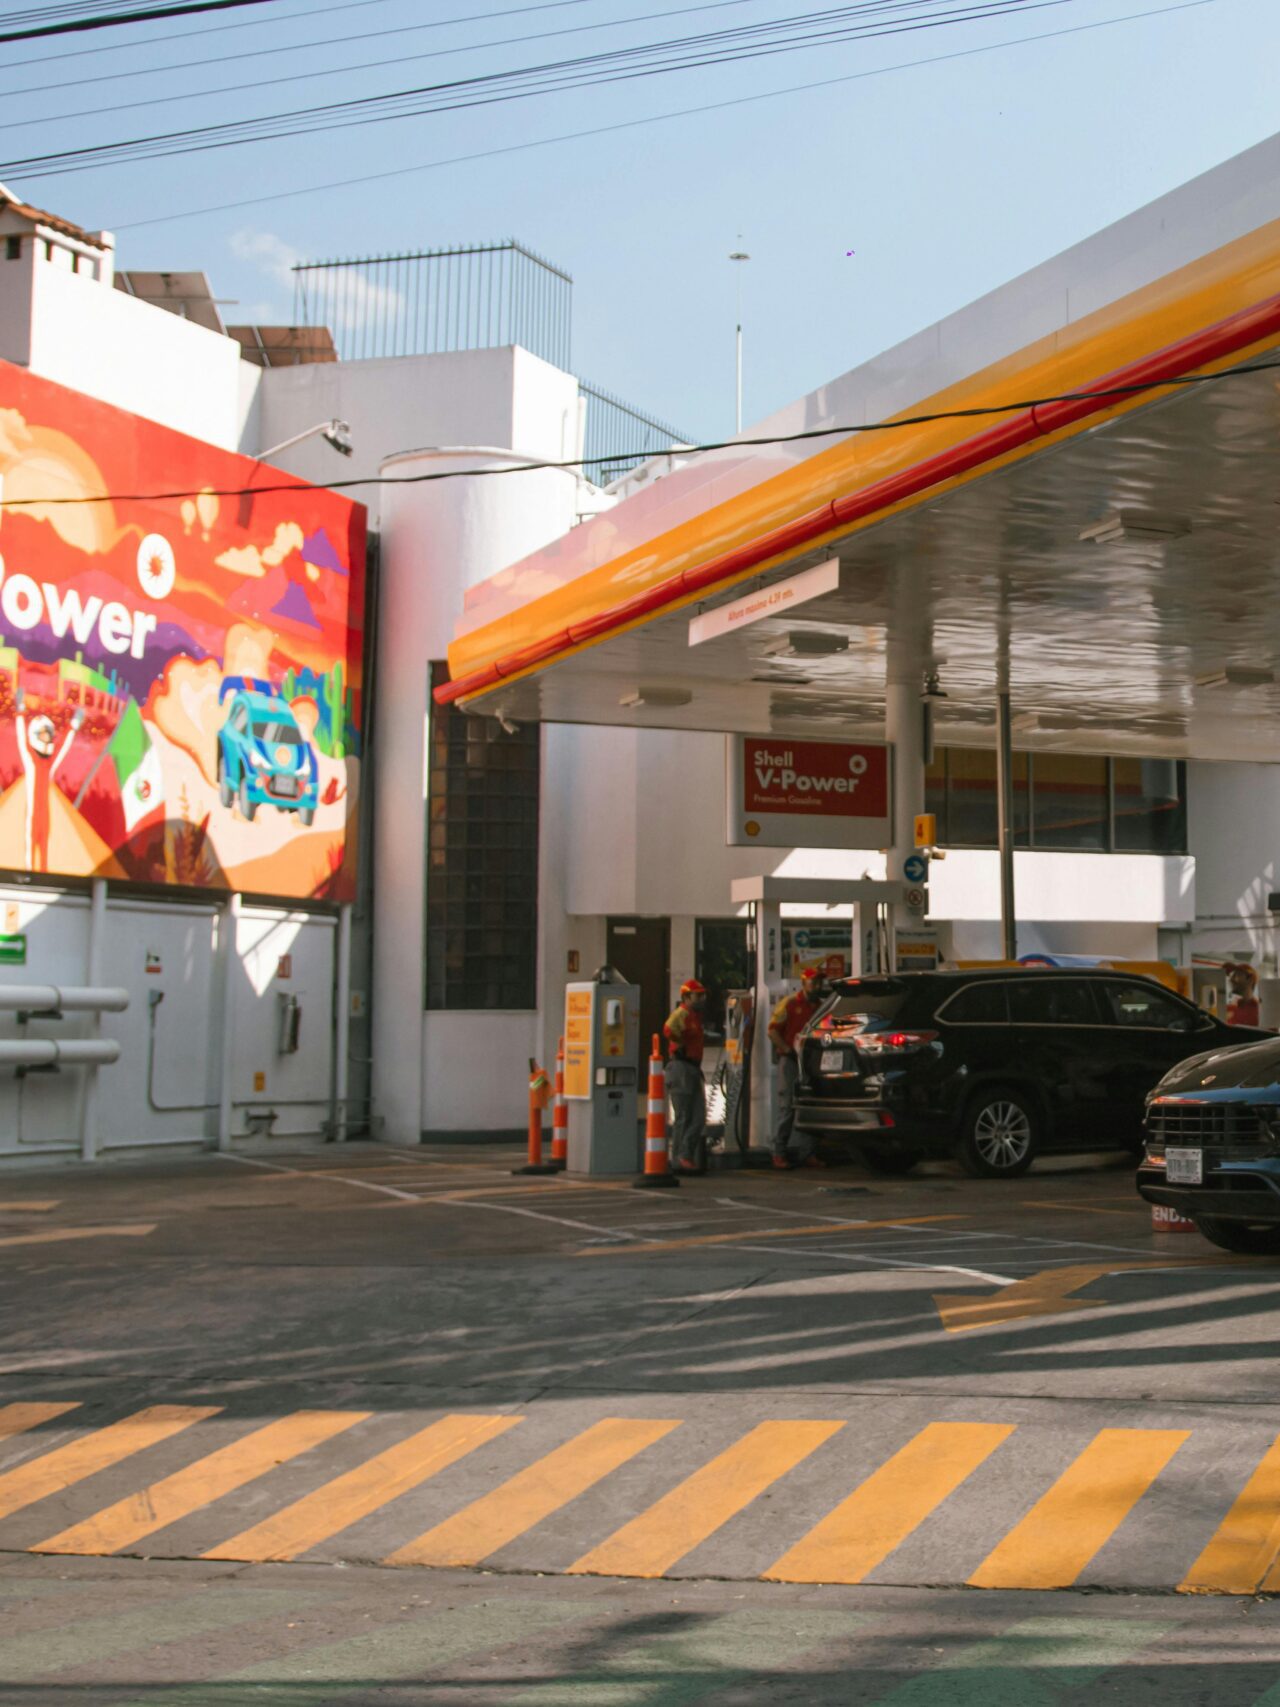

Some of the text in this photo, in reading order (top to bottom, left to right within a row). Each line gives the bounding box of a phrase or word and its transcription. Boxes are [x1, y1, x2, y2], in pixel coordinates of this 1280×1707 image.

[0, 552, 157, 660] ower
[754, 750, 793, 767] Shell
[754, 768, 859, 793] V-Power
